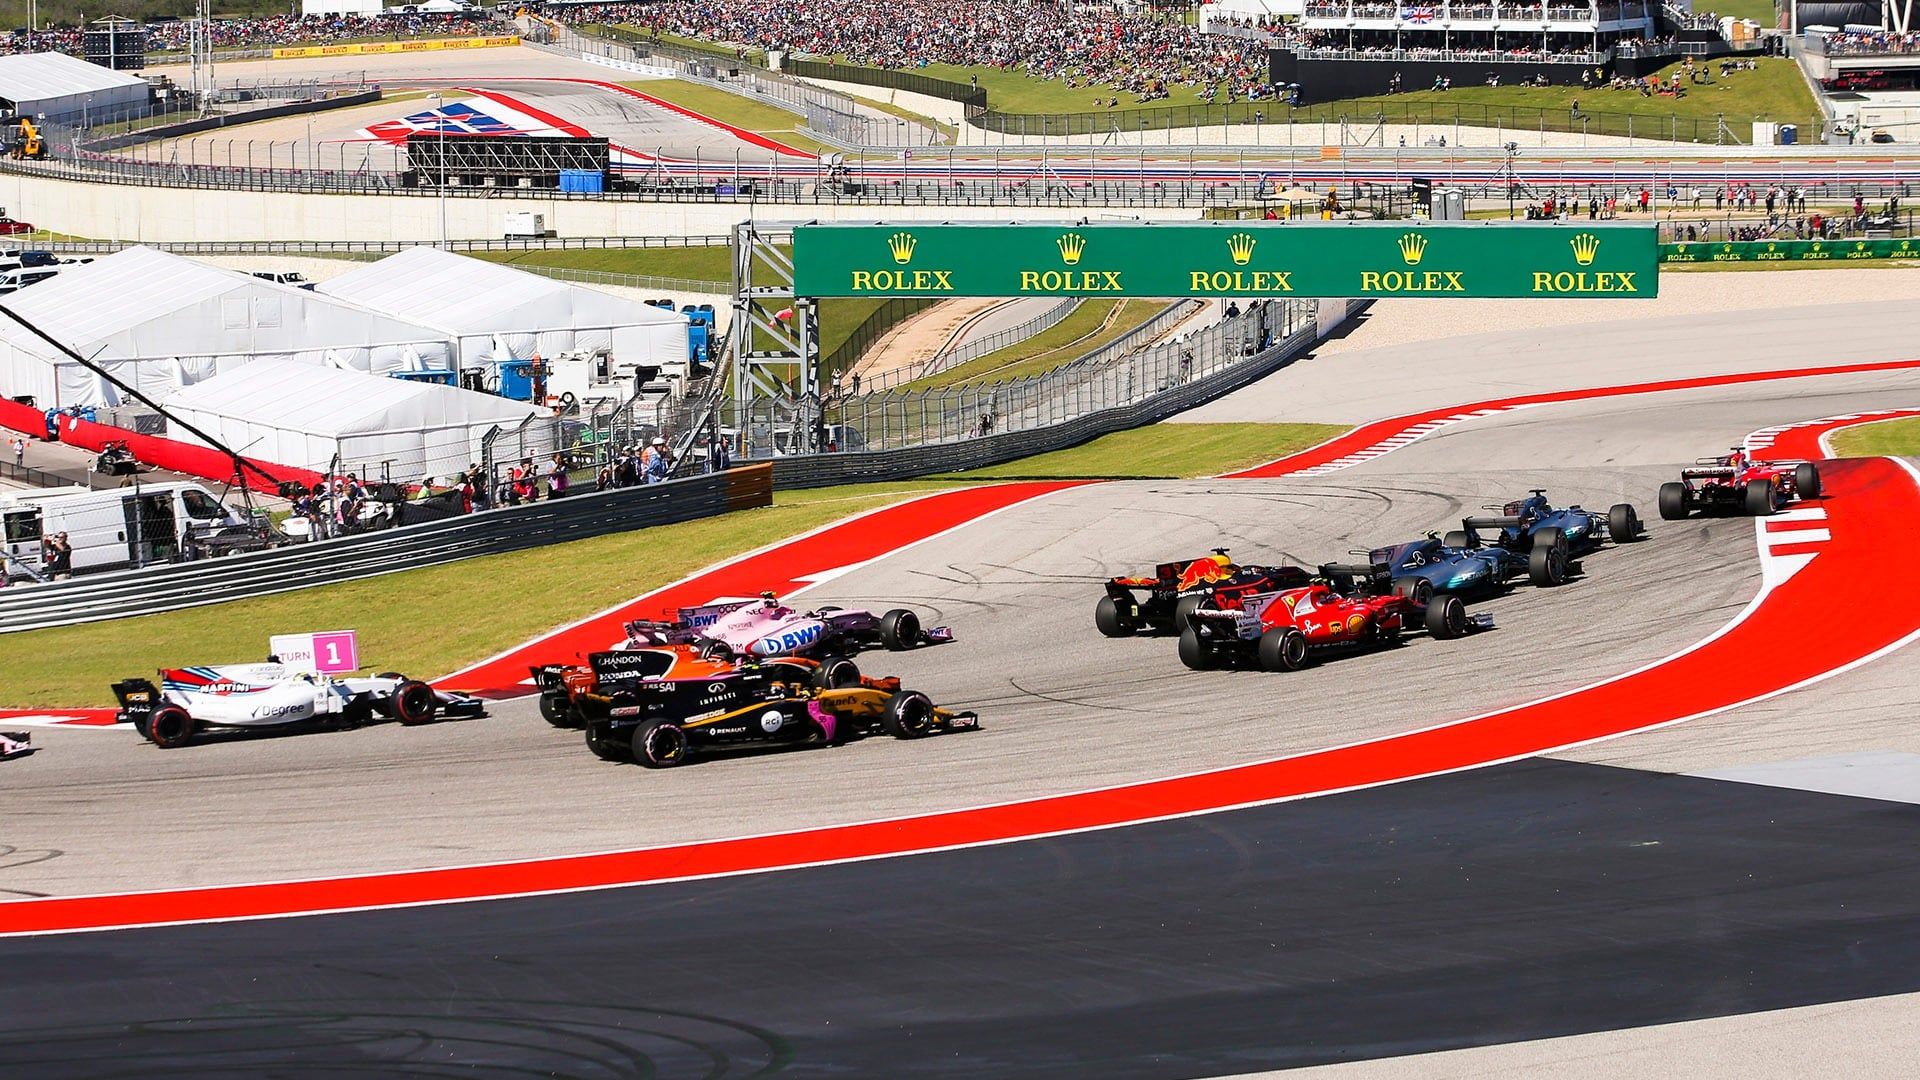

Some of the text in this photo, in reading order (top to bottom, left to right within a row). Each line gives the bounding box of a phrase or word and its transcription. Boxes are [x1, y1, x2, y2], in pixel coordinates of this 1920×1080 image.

[1667, 254, 1695, 262] ROLEX
[1713, 253, 1741, 261] ROLEX
[1757, 252, 1785, 260] ROLEX
[1803, 252, 1830, 260] ROLEX
[1847, 251, 1873, 259] ROLEX
[1891, 250, 1919, 258] ROLEX
[854, 271, 951, 289] ROLEX
[1022, 272, 1120, 290] ROLEX
[1192, 272, 1291, 290] ROLEX
[1363, 272, 1462, 290] ROLEX
[1535, 272, 1635, 291] ROLEX
[718, 605, 738, 613] OCO
[745, 607, 764, 615] NEC
[693, 614, 718, 628] BWT
[1330, 623, 1342, 634] ups
[782, 624, 823, 651] BWT
[279, 641, 341, 665] TURN 1
[599, 670, 642, 680] HONDA
[200, 682, 251, 694] MARTINI
[659, 682, 675, 692] SAI
[700, 692, 737, 705] INFINITI
[262, 703, 305, 718] Degree
[716, 726, 747, 735] RENAULT
